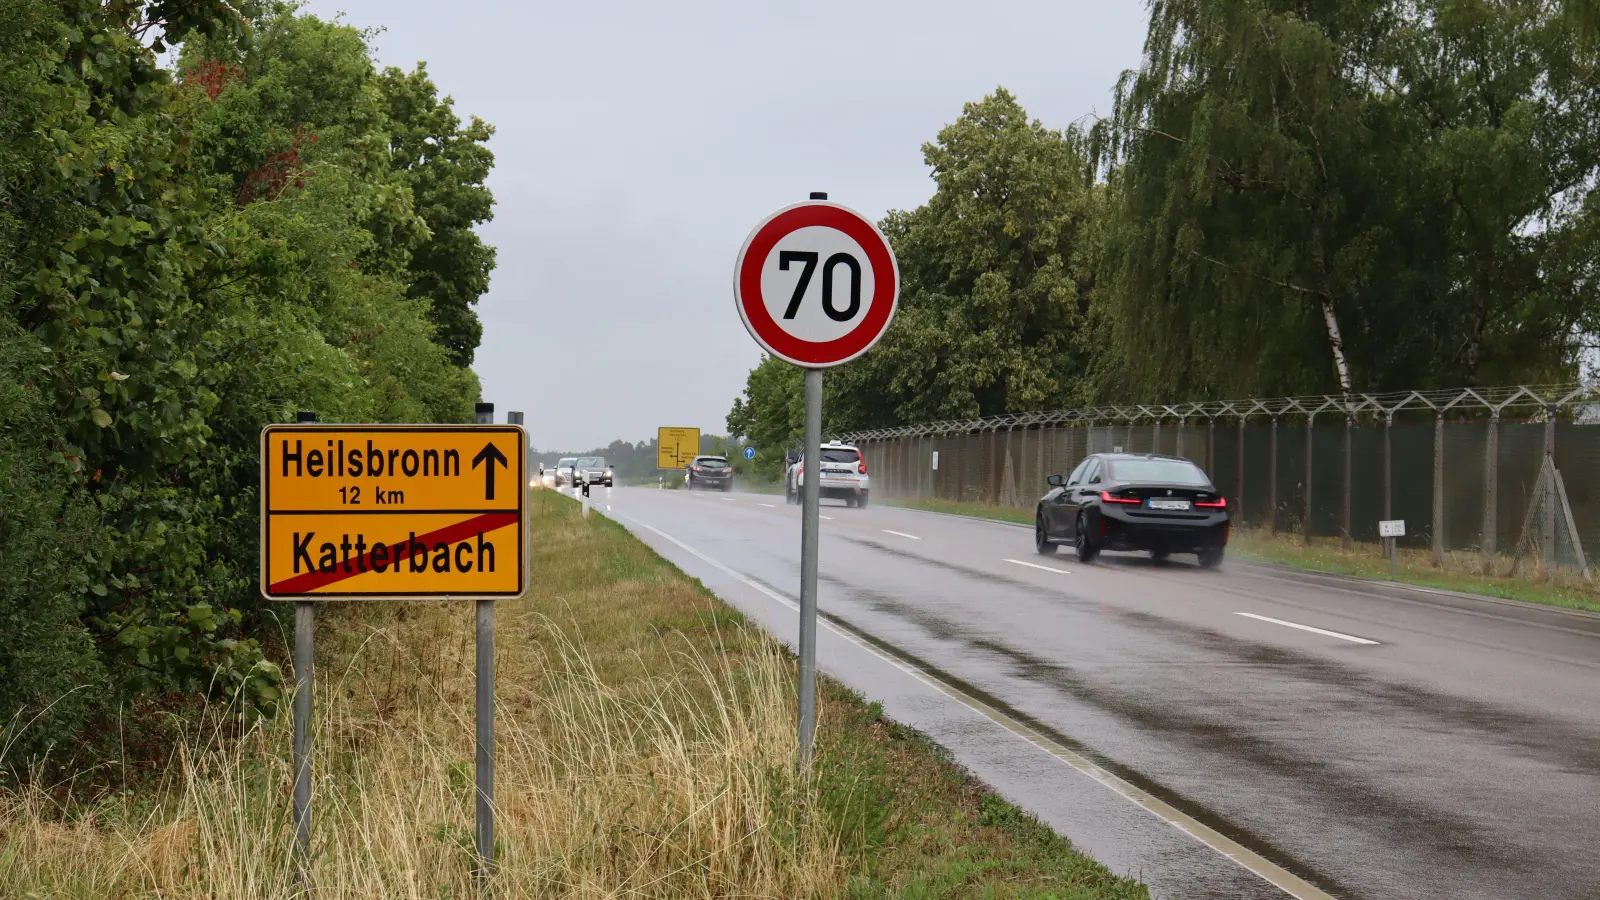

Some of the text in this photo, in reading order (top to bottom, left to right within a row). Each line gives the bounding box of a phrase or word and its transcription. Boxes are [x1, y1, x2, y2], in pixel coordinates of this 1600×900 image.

[780, 250, 861, 321] 70
[282, 439, 459, 477] Heilsbronn
[339, 487, 404, 504] 12 km
[293, 532, 494, 574] Katterbach
